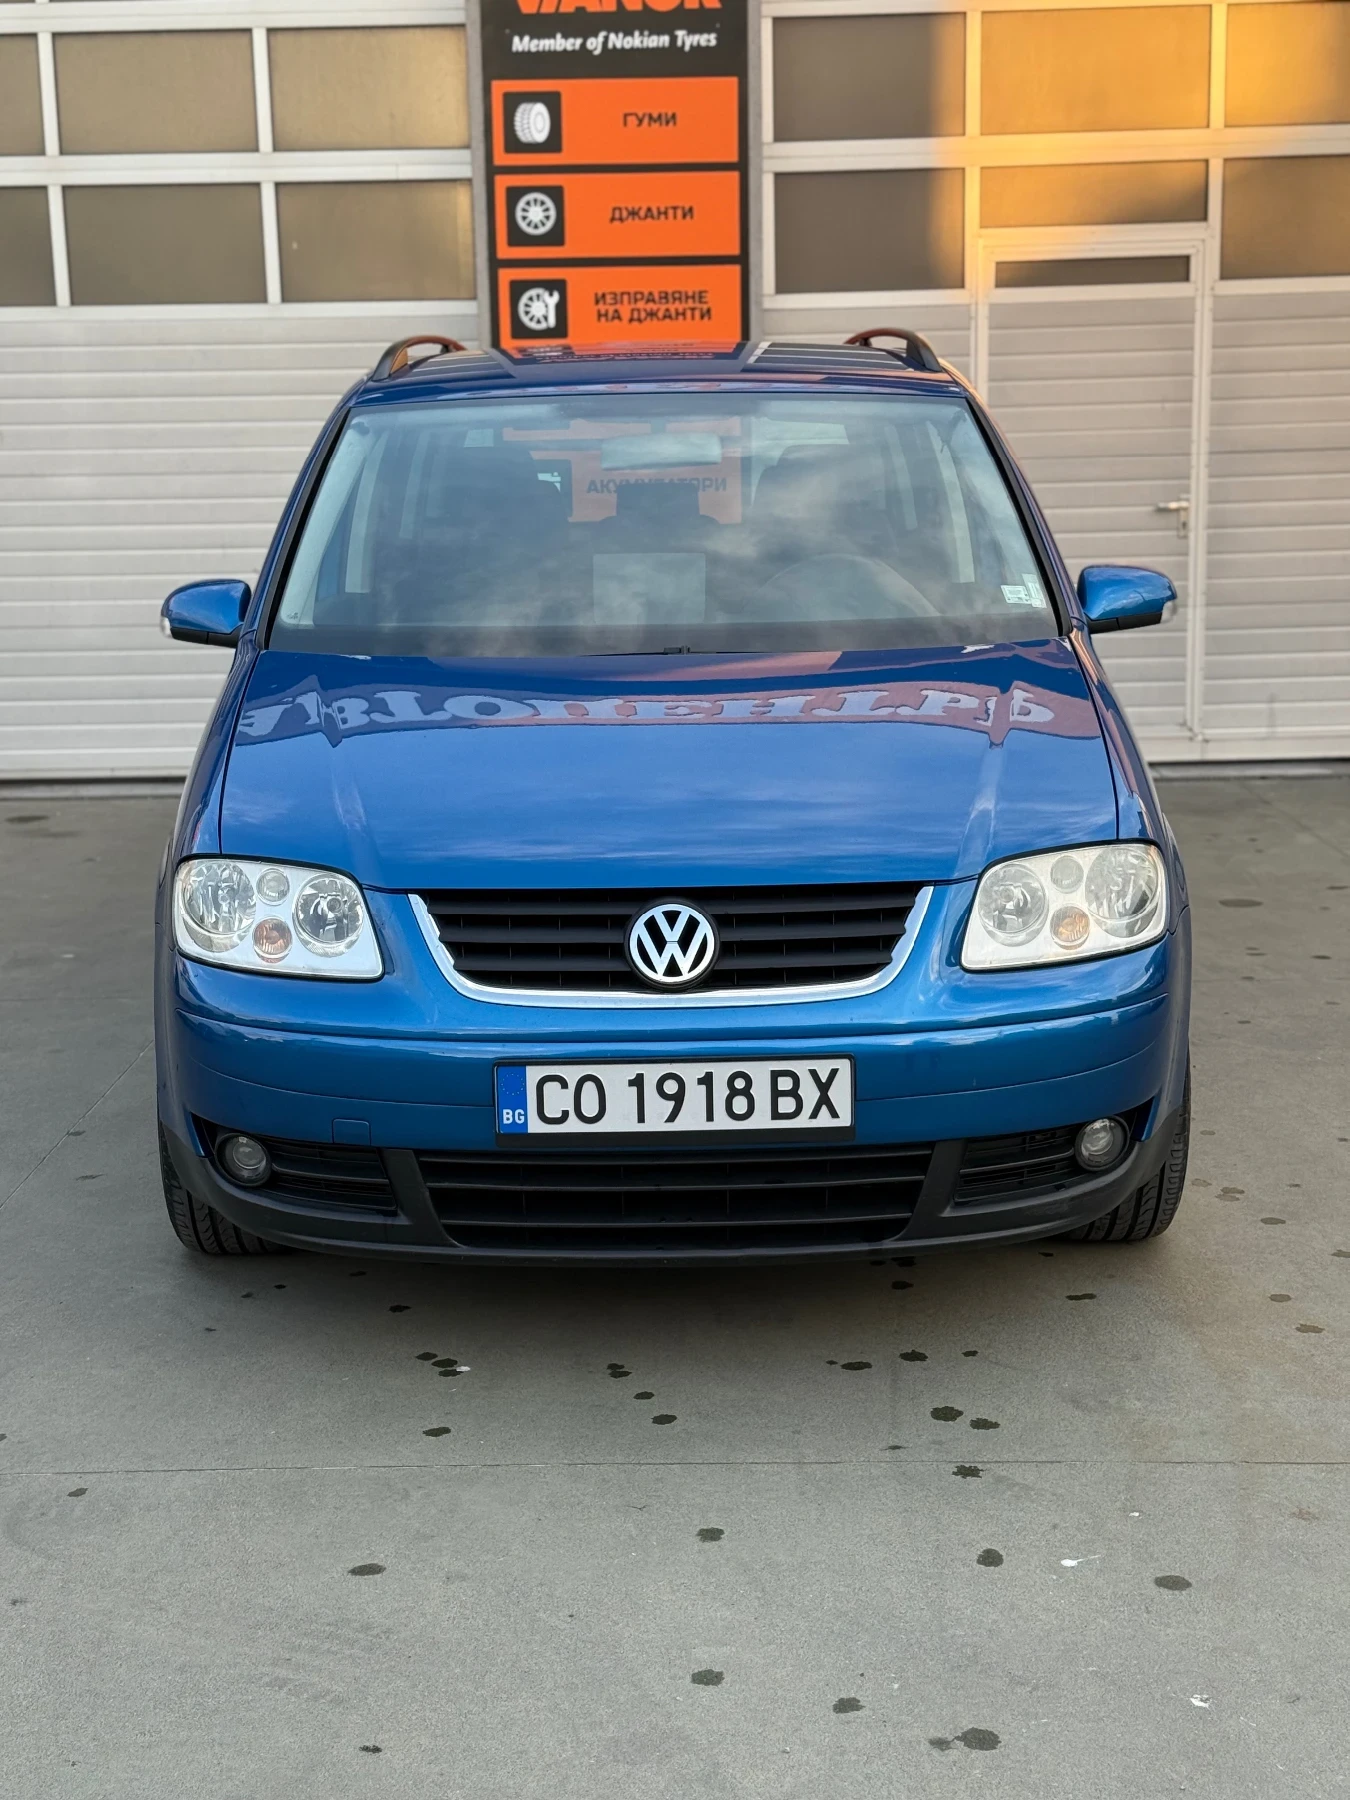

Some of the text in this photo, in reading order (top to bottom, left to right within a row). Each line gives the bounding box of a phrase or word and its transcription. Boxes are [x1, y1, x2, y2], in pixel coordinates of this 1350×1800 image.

[511, 29, 718, 55] Member of Nokian Tyres
[623, 111, 677, 128] ГУМИ
[609, 205, 694, 224] ДЖАНТИ
[594, 290, 709, 307] ИЗПРАВЯНЕ
[597, 306, 712, 325] НА ДЖАНТИ
[536, 1067, 841, 1125] CO 1918 BX
[502, 1108, 525, 1124] BG
